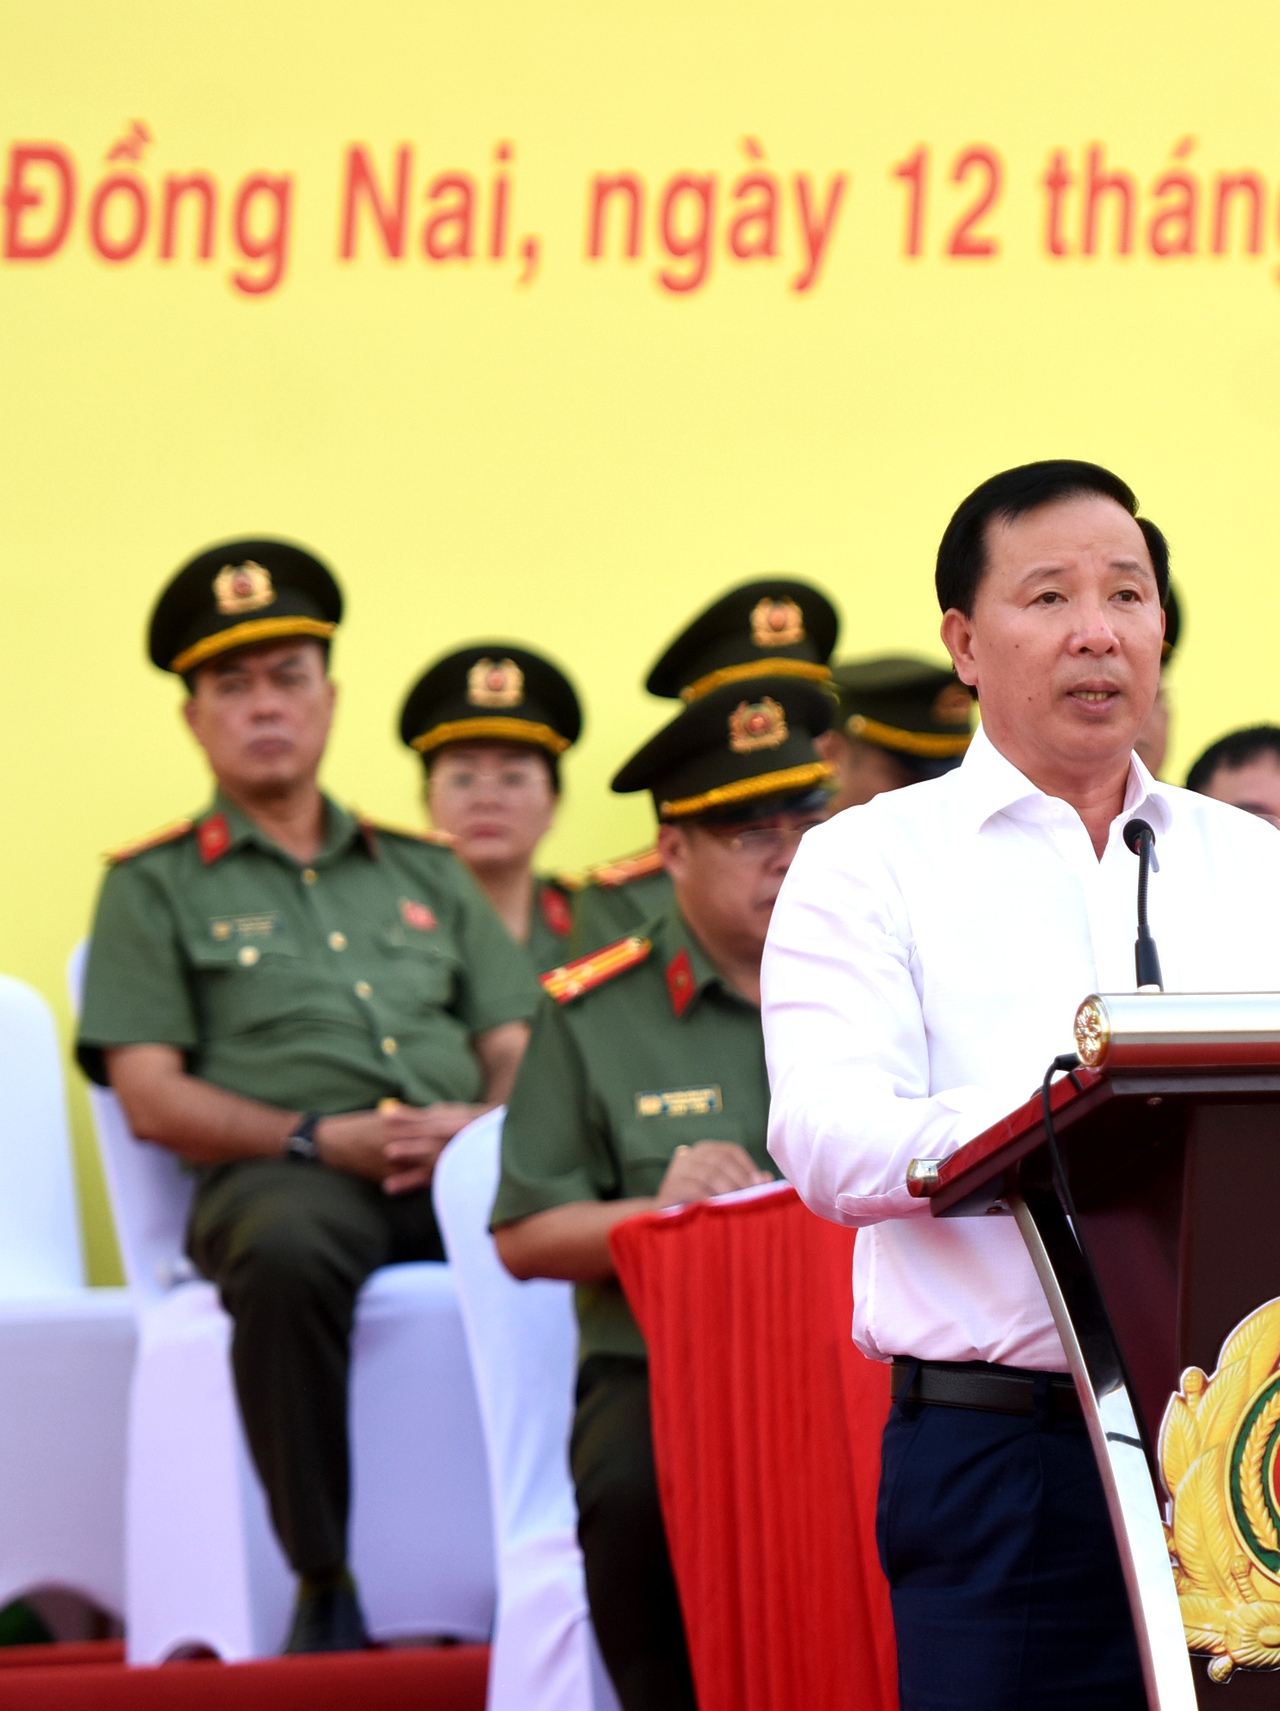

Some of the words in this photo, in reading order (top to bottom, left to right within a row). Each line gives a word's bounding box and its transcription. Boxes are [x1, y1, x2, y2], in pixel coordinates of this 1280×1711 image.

[0, 122, 294, 297] Đồng
[337, 140, 541, 285] Nai,
[585, 137, 848, 296] ngày
[892, 144, 1004, 261] 12
